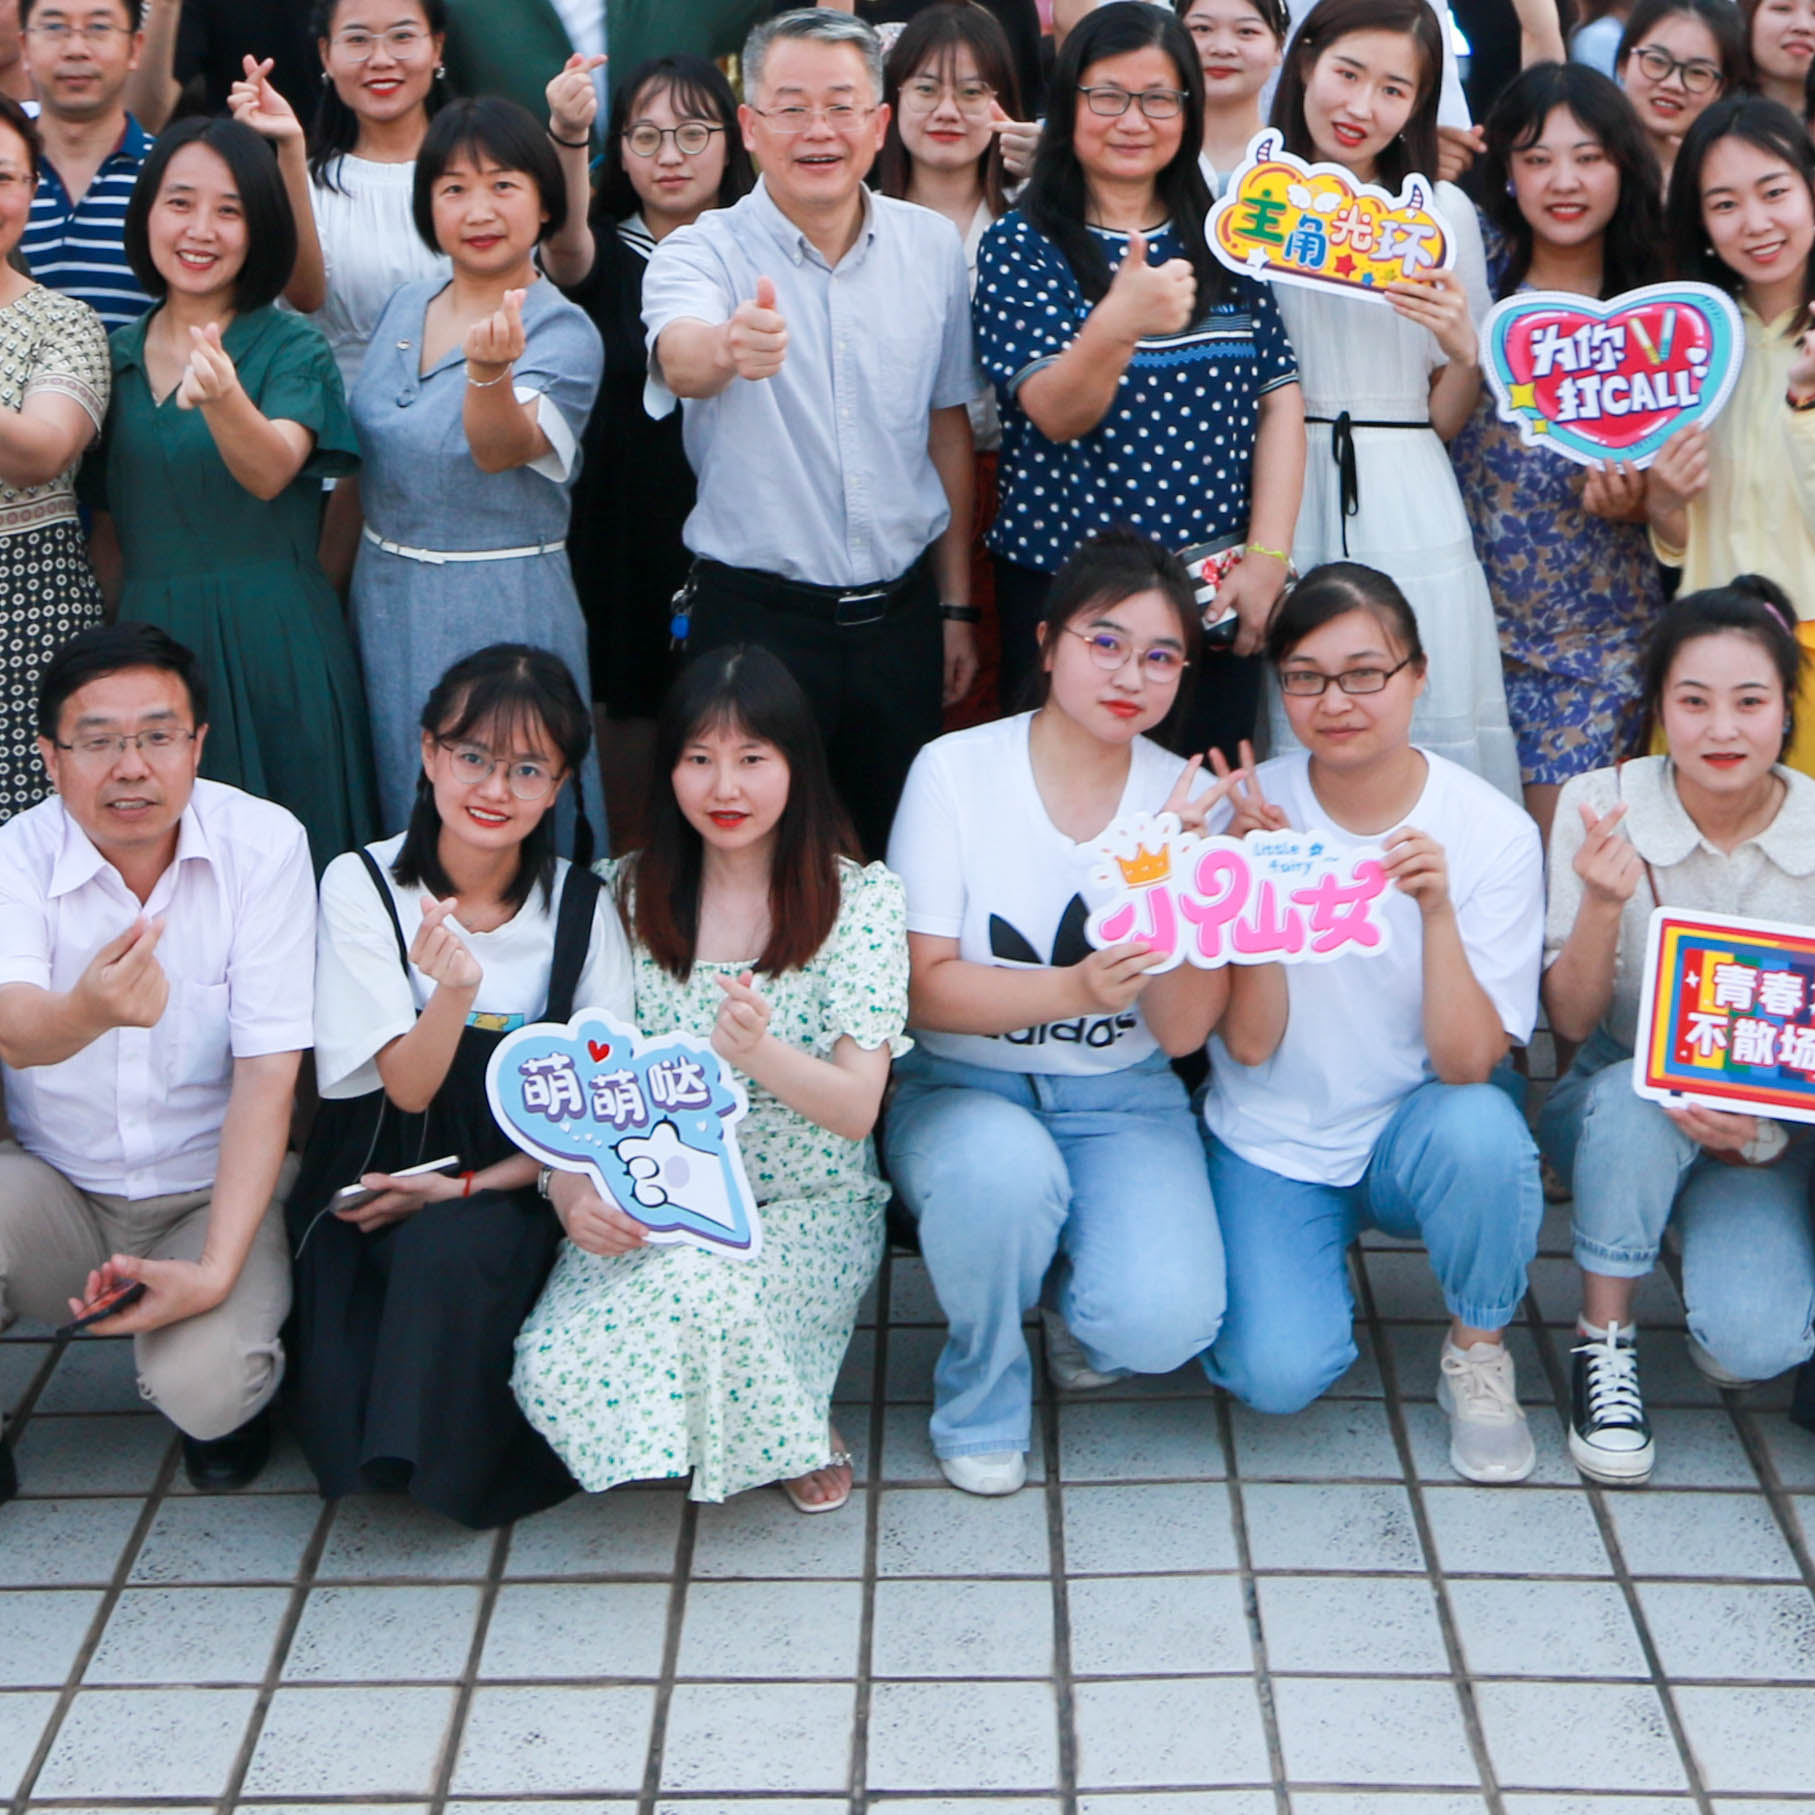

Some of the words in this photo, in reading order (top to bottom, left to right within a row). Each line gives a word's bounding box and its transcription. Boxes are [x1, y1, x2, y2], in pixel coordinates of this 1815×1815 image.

[1235, 187, 1438, 275] 主角光环
[1530, 321, 1626, 378] 为你
[1554, 370, 1701, 423] 打CALL
[1100, 848, 1389, 960] 小仙女
[1711, 961, 1806, 1019] 青春
[520, 1051, 713, 1129] 萌萌哒
